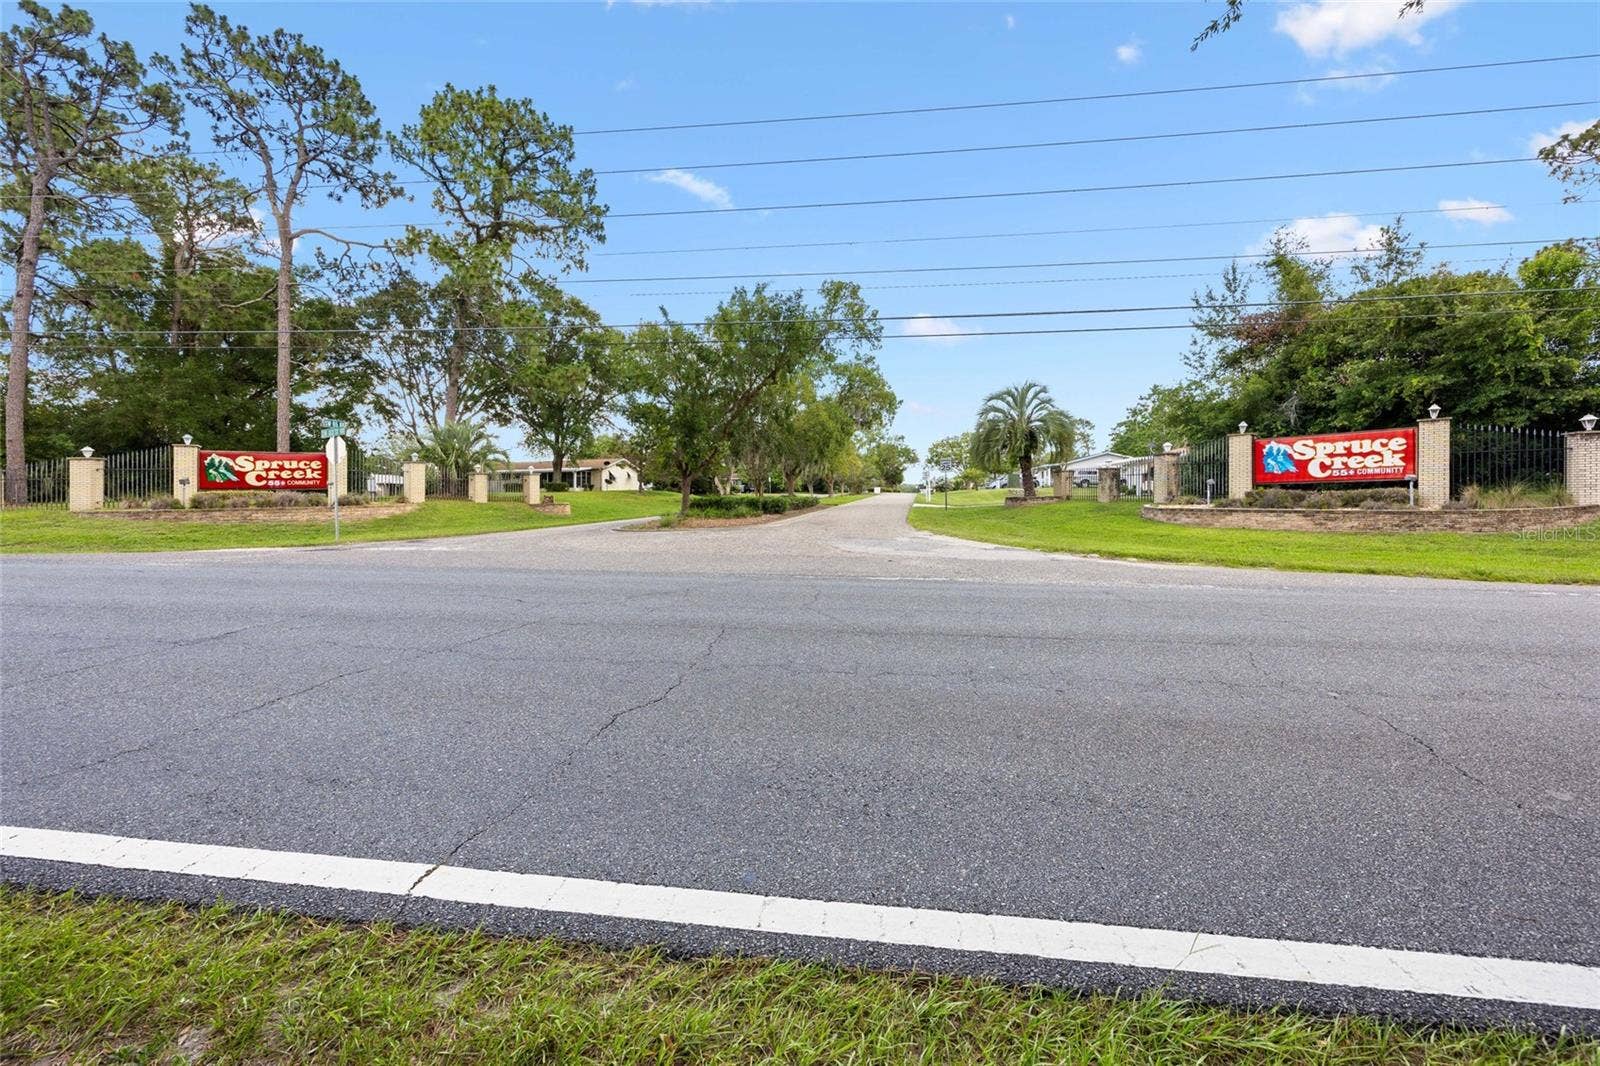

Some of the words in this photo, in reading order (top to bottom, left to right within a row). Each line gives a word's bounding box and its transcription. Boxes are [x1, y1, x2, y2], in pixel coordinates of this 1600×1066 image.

[1293, 437, 1407, 460] Spruce
[235, 455, 322, 472] Spruce
[1308, 450, 1406, 478] Creek
[1332, 469, 1356, 477] 55+
[1357, 467, 1404, 475] COMMUNITY
[244, 469, 322, 487] Creek
